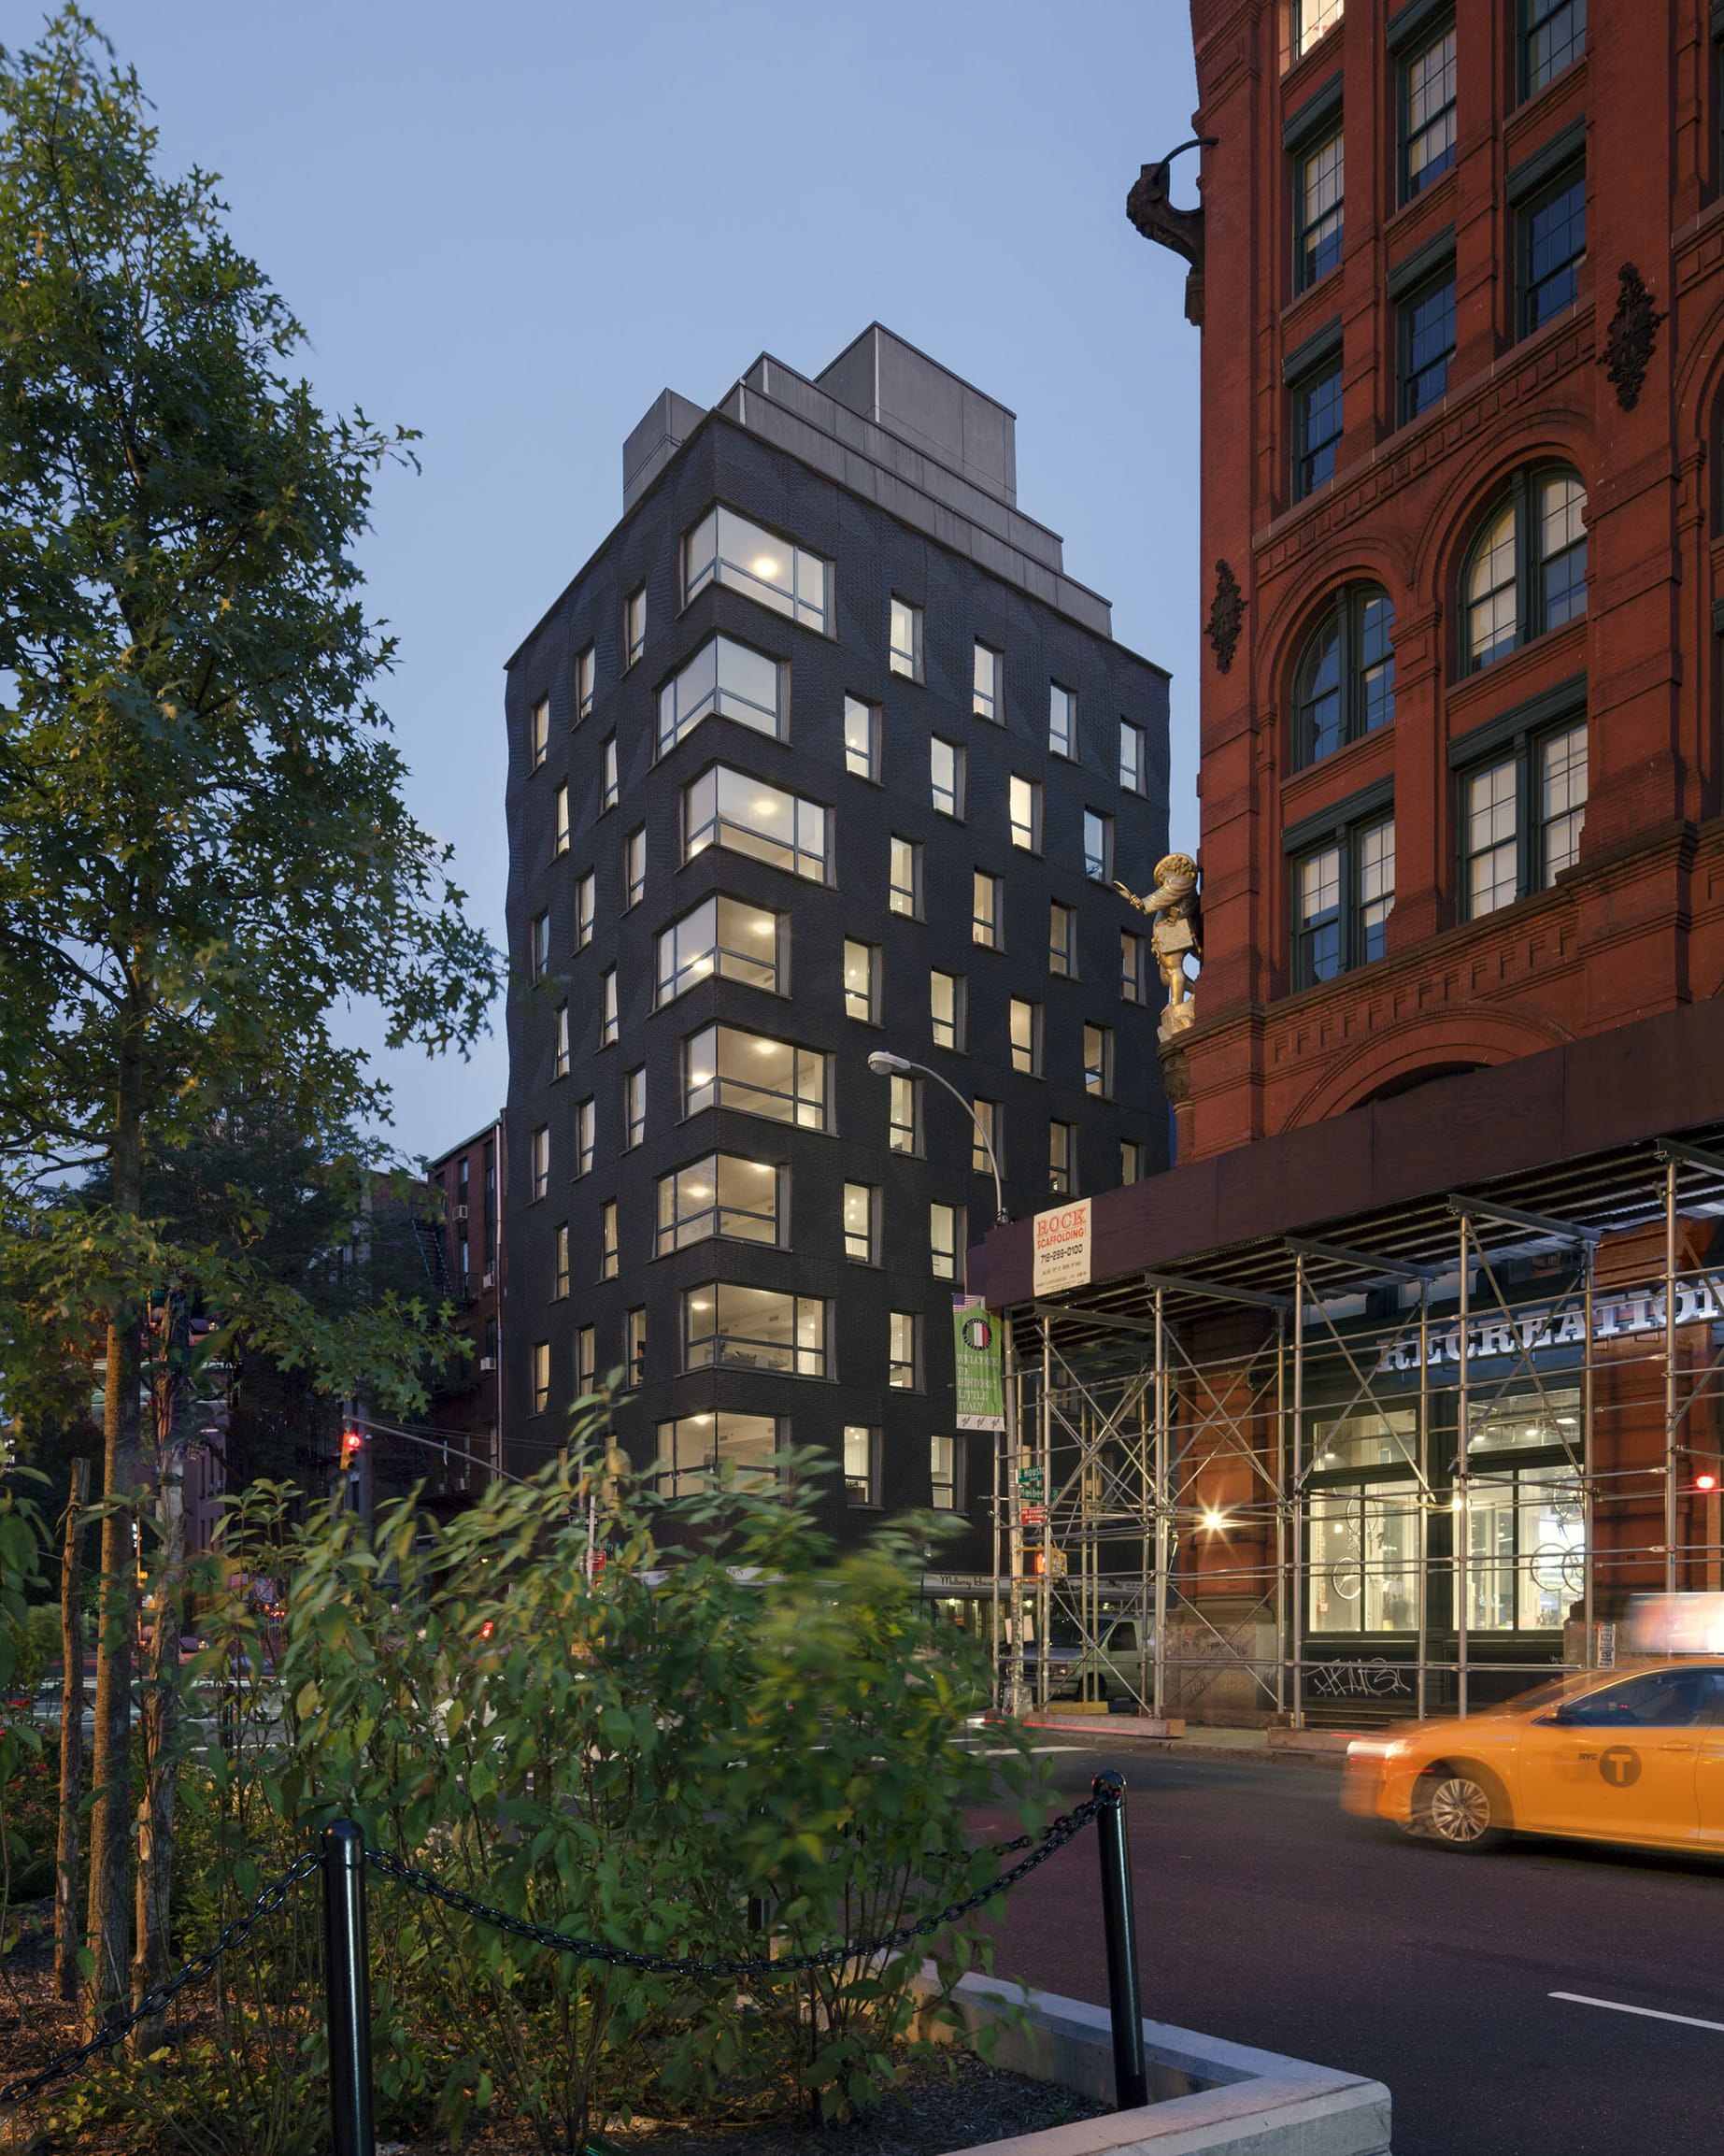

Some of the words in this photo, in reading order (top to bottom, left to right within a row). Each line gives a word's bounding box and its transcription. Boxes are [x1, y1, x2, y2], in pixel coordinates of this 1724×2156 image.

[1037, 1207, 1087, 1236] ROCK
[1037, 1227, 1085, 1249] SCAFFOLDING
[957, 1365, 969, 1376] TO
[958, 1390, 989, 1401] LITTLE
[958, 1402, 985, 1412] ITALY
[940, 1576, 972, 1590] Mulberry
[1578, 1752, 1599, 1761] NYC
